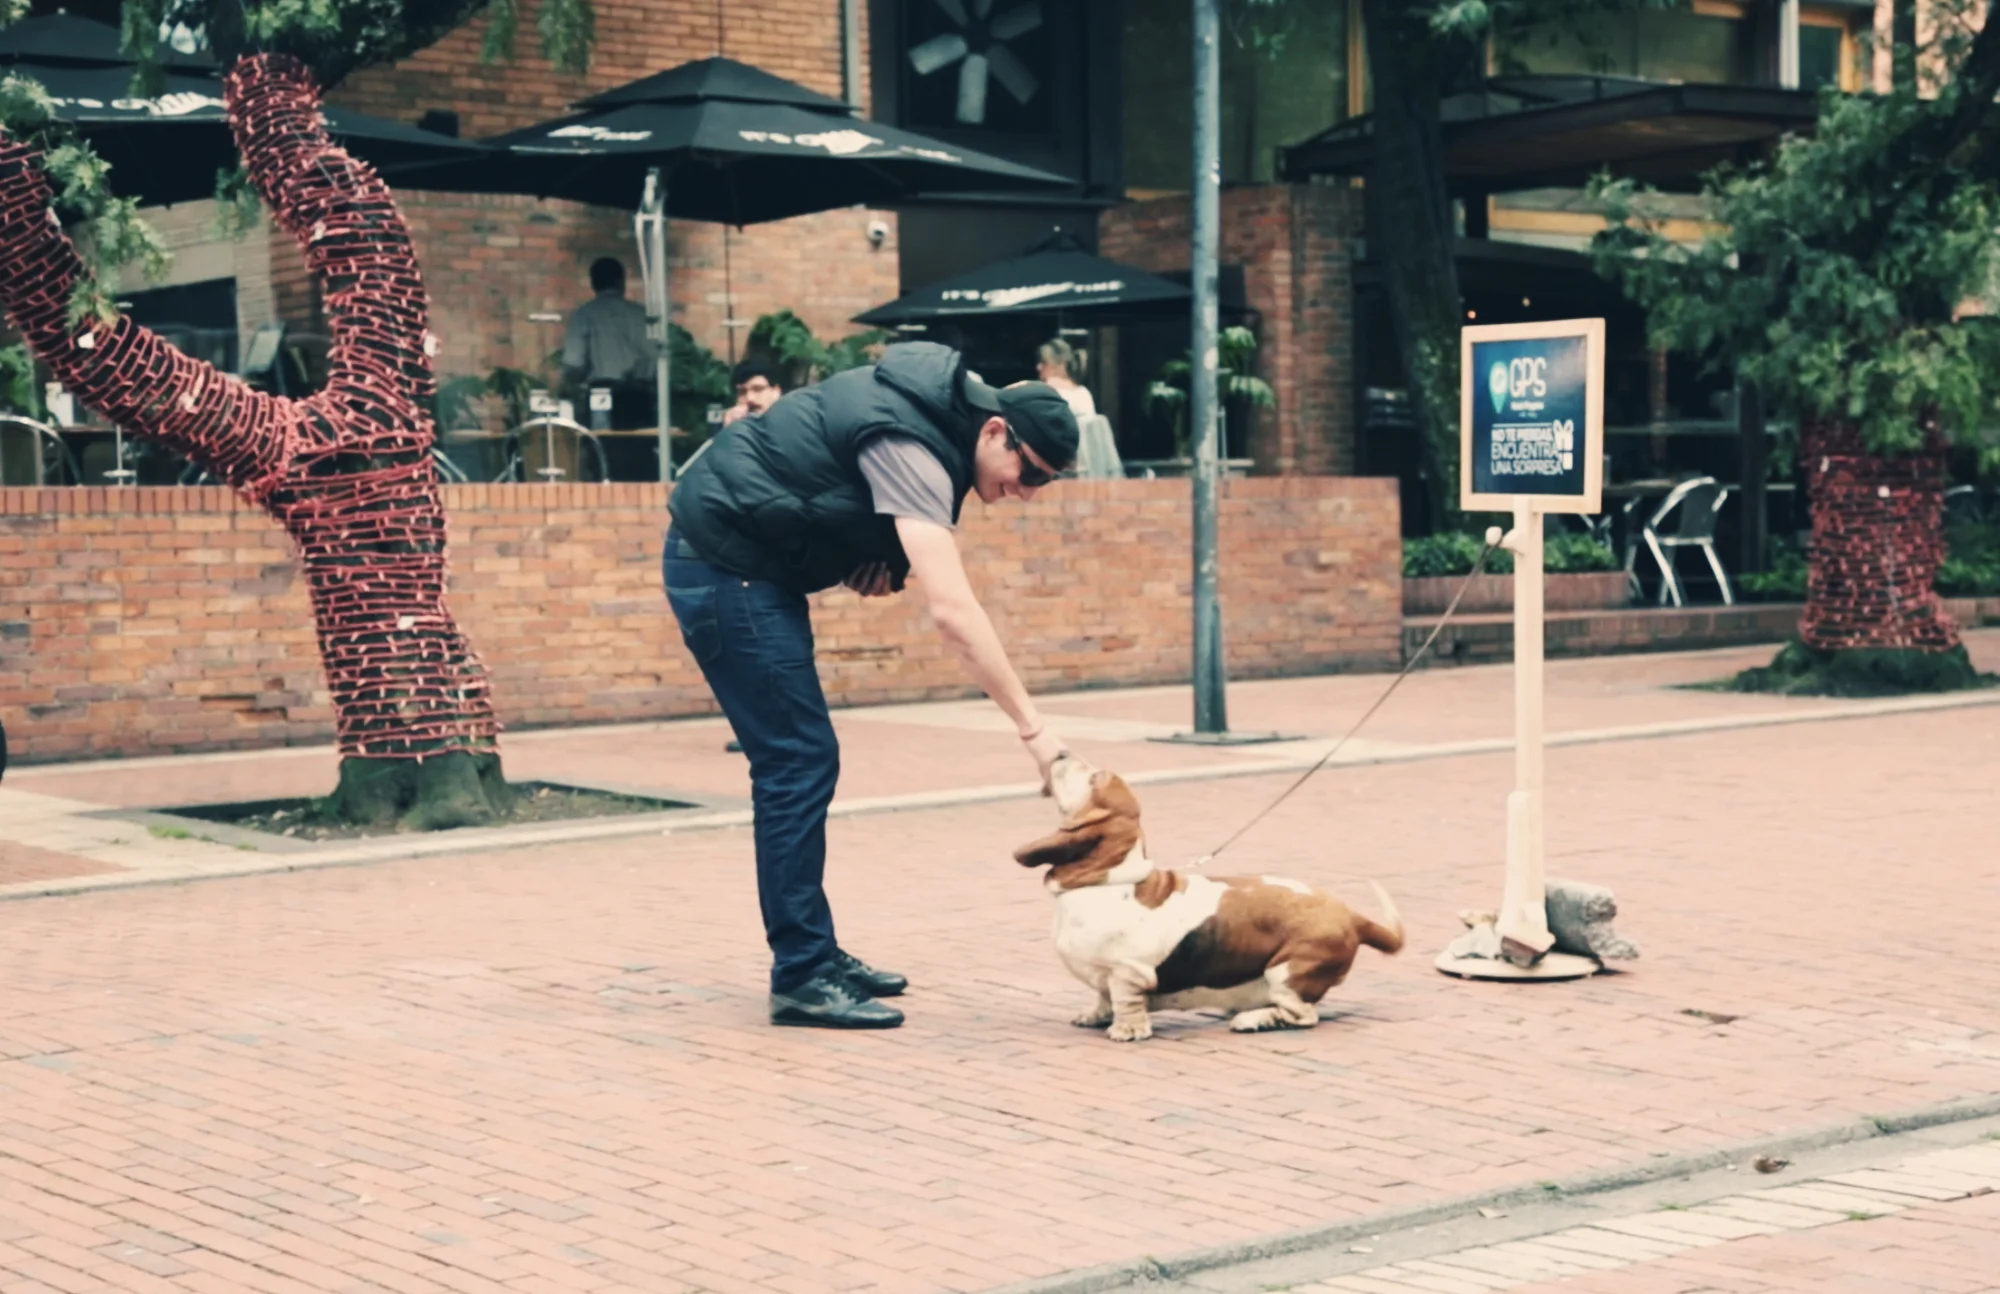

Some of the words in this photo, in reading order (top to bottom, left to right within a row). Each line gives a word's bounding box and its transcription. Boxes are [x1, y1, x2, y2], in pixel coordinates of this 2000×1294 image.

[1510, 357, 1547, 397] GPS
[1492, 442, 1558, 459] ENCUENTRA
[1491, 461, 1513, 475] UNA
[1514, 460, 1563, 475] SORPRESA
